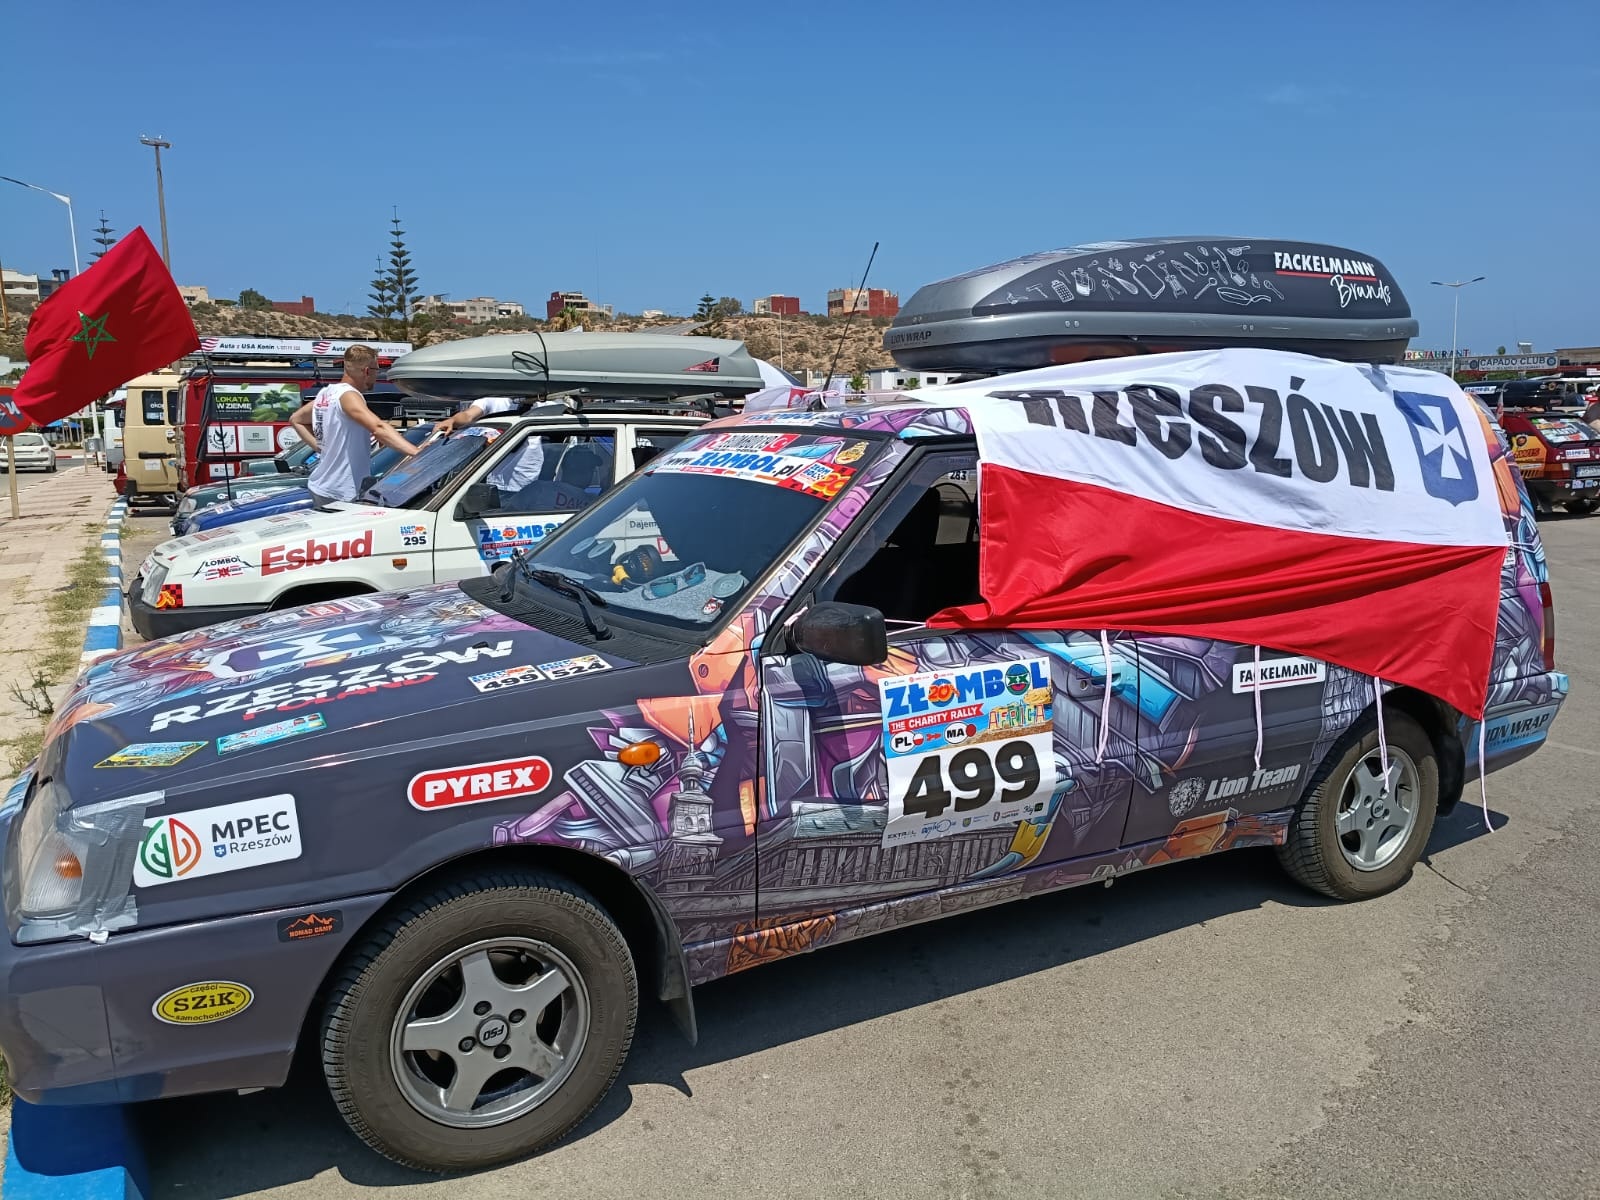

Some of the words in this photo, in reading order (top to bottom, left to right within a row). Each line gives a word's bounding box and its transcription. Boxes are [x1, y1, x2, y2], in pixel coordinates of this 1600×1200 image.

[1274, 252, 1376, 277] FACKELMANN
[1330, 274, 1391, 308] Brands
[906, 330, 932, 341] WRAP
[1480, 358, 1518, 366] CAPADO
[1520, 356, 1546, 364] CLUB
[216, 402, 226, 410] W
[403, 536, 427, 545] 295
[261, 530, 373, 577] Esbud
[551, 661, 605, 678] 524
[1239, 662, 1318, 683] FAKELMANN
[149, 639, 514, 732] RZESZÓW
[483, 673, 540, 690] 499
[885, 661, 1048, 718] ZŁOMBOL
[243, 673, 436, 720] POLAND
[891, 721, 906, 731] THE
[908, 713, 948, 728] CHARITY
[950, 706, 979, 721] RALLY
[1510, 713, 1550, 736] WRAP
[894, 735, 912, 748] PL
[946, 727, 965, 738] MA
[425, 766, 535, 802] PYREX
[902, 740, 1041, 819] 499
[1205, 777, 1249, 801] Lion
[1250, 764, 1301, 791] Team
[211, 810, 290, 842] MPEC
[229, 834, 293, 854] Rzeszów
[289, 927, 313, 938] NOMAD
[314, 924, 333, 935] CAMP
[189, 983, 219, 994] części
[173, 991, 236, 1014] SZiK
[175, 1006, 237, 1022] samochodowe
[482, 1024, 505, 1042] FSO
